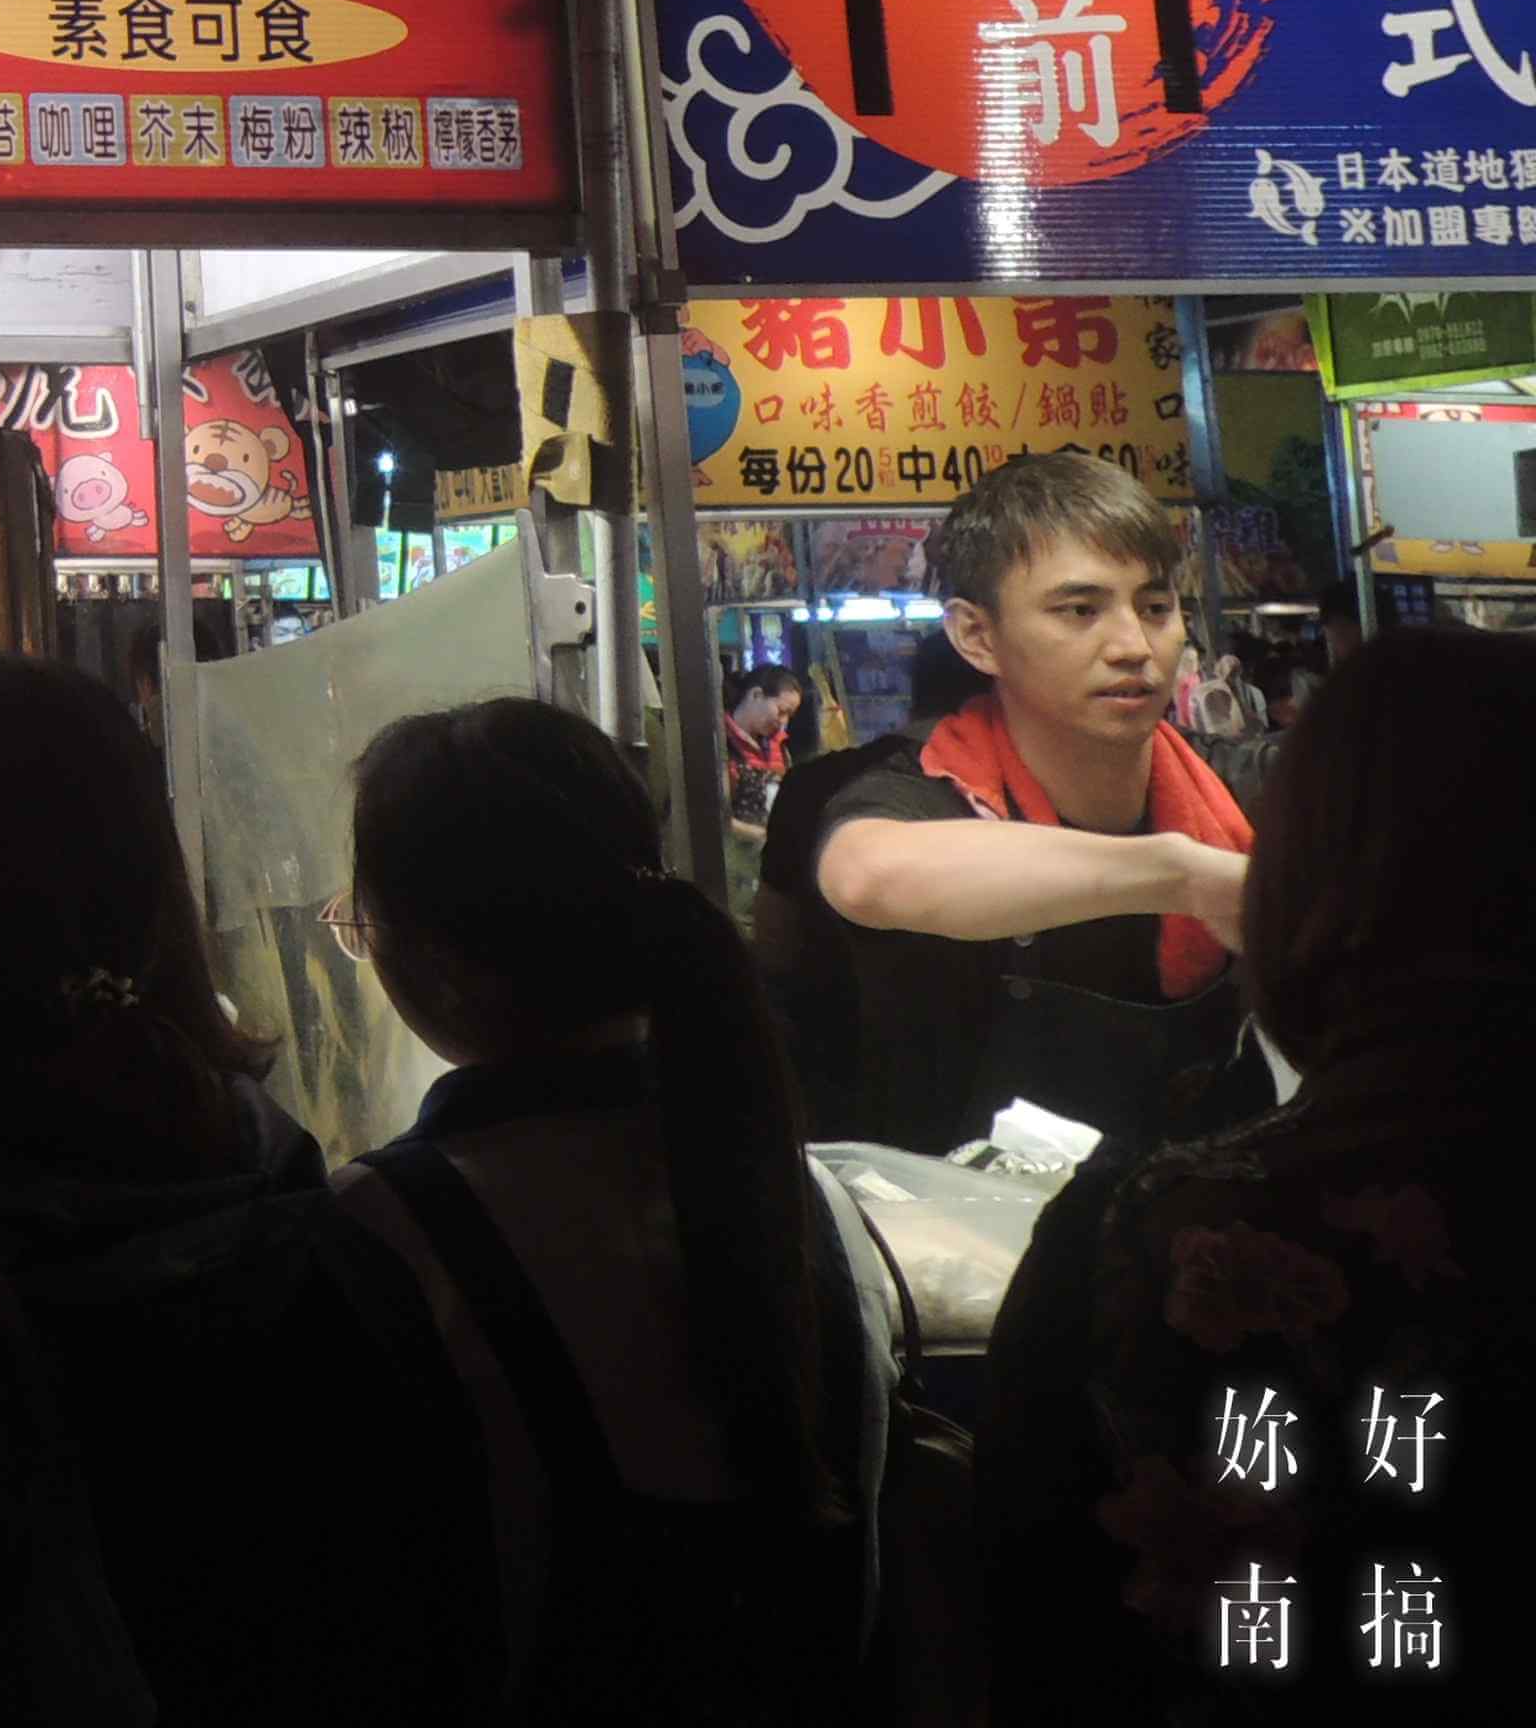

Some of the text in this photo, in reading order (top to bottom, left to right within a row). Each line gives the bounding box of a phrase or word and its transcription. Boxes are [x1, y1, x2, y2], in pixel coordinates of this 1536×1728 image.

[38, 104, 118, 160] 咖哩
[138, 104, 220, 160] 芥末
[240, 108, 319, 161] 梅粉
[339, 110, 420, 163] 辣椒
